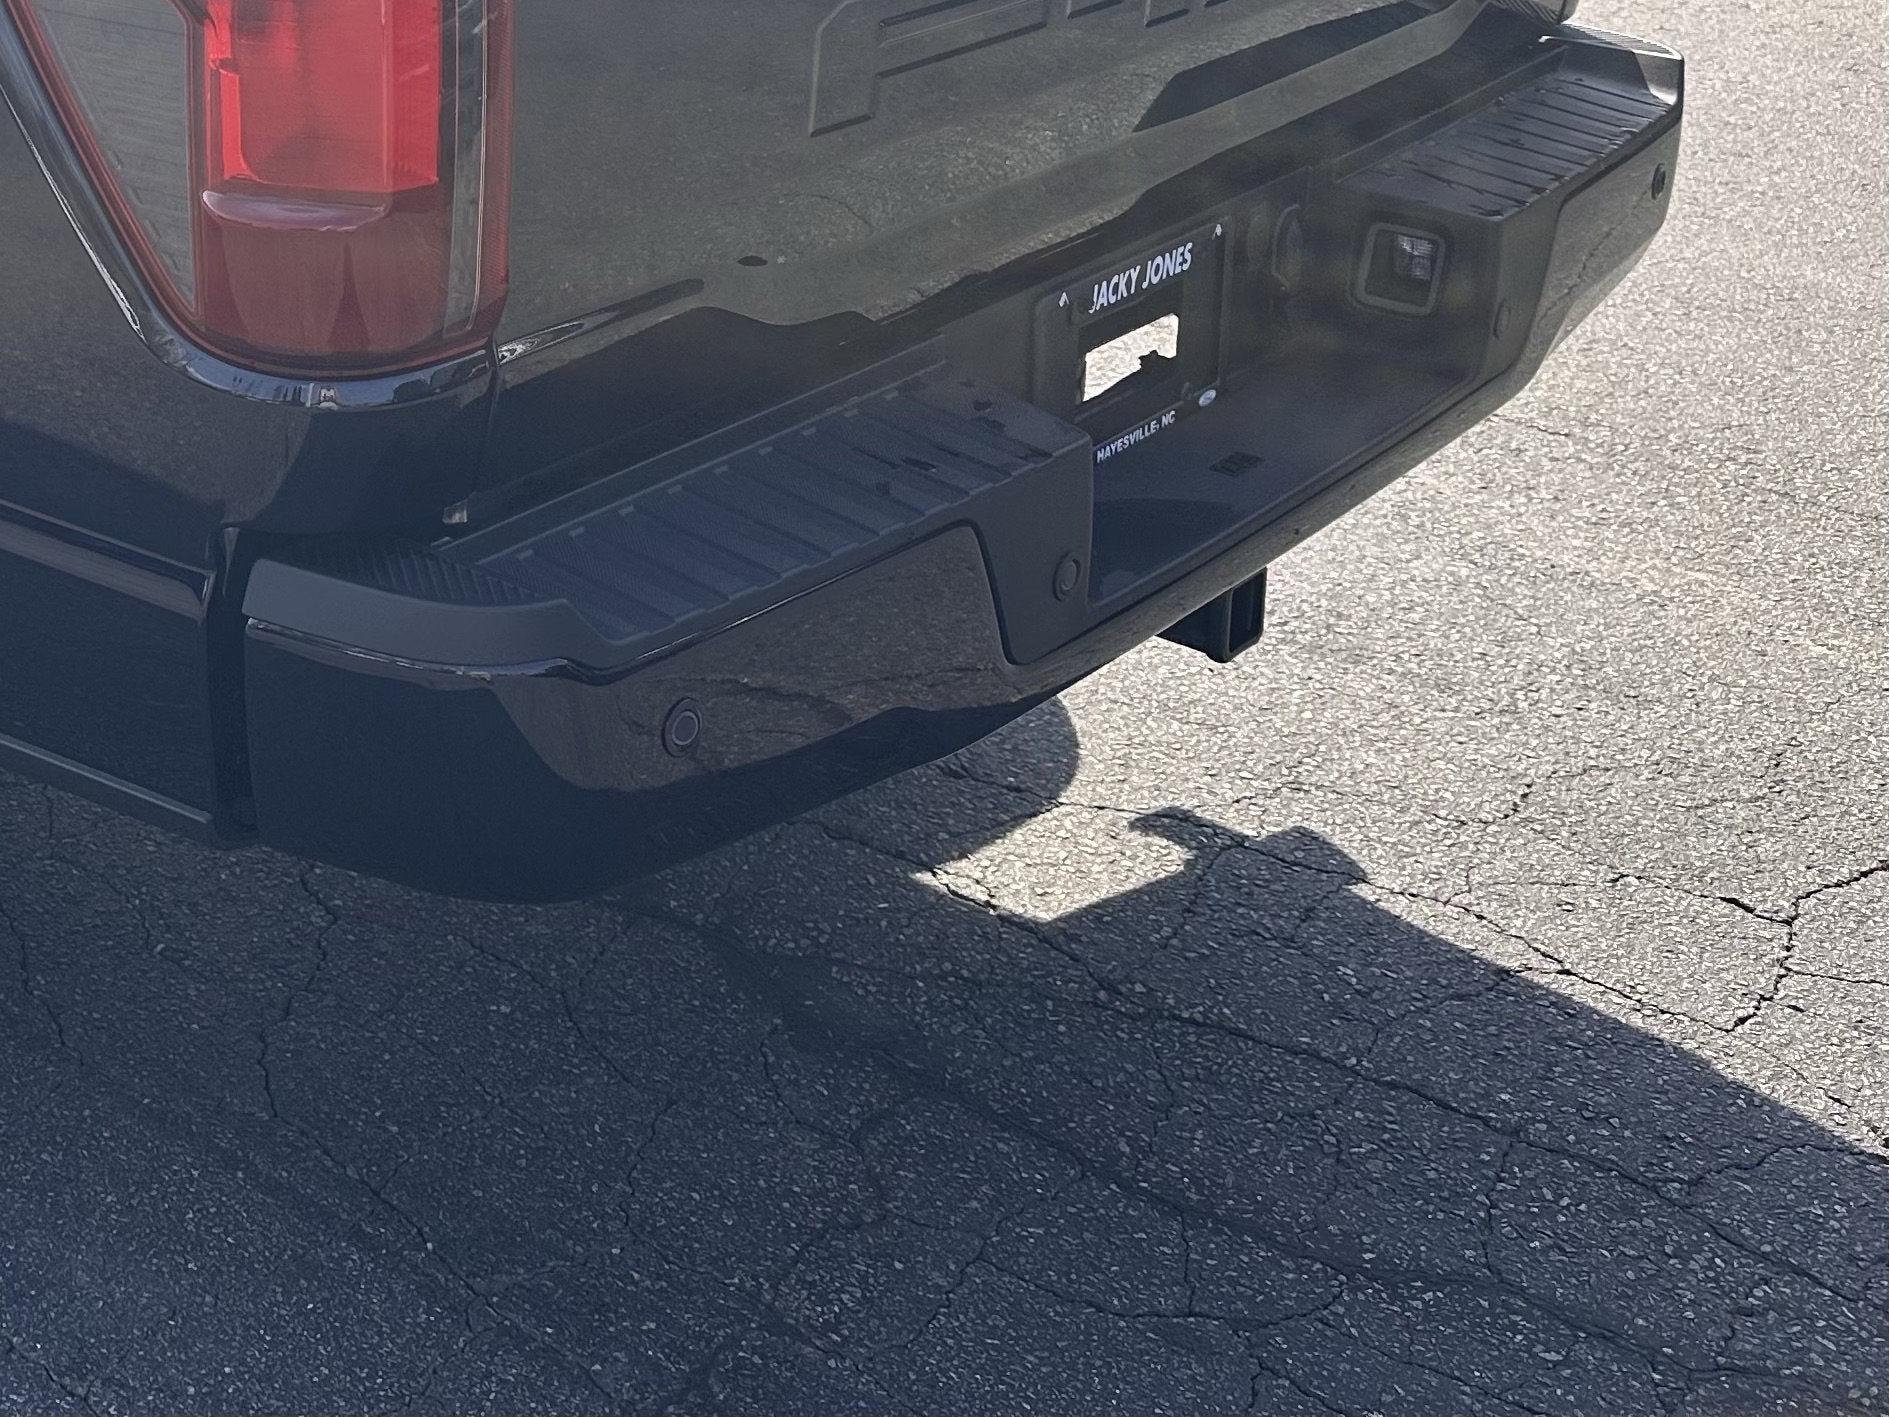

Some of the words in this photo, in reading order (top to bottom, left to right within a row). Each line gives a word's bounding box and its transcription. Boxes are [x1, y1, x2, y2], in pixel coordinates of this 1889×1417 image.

[1088, 265, 1142, 314] JACKY
[1141, 242, 1193, 289] JONES
[1096, 419, 1160, 464] HAYESVILLE,
[1161, 410, 1176, 427] NC
